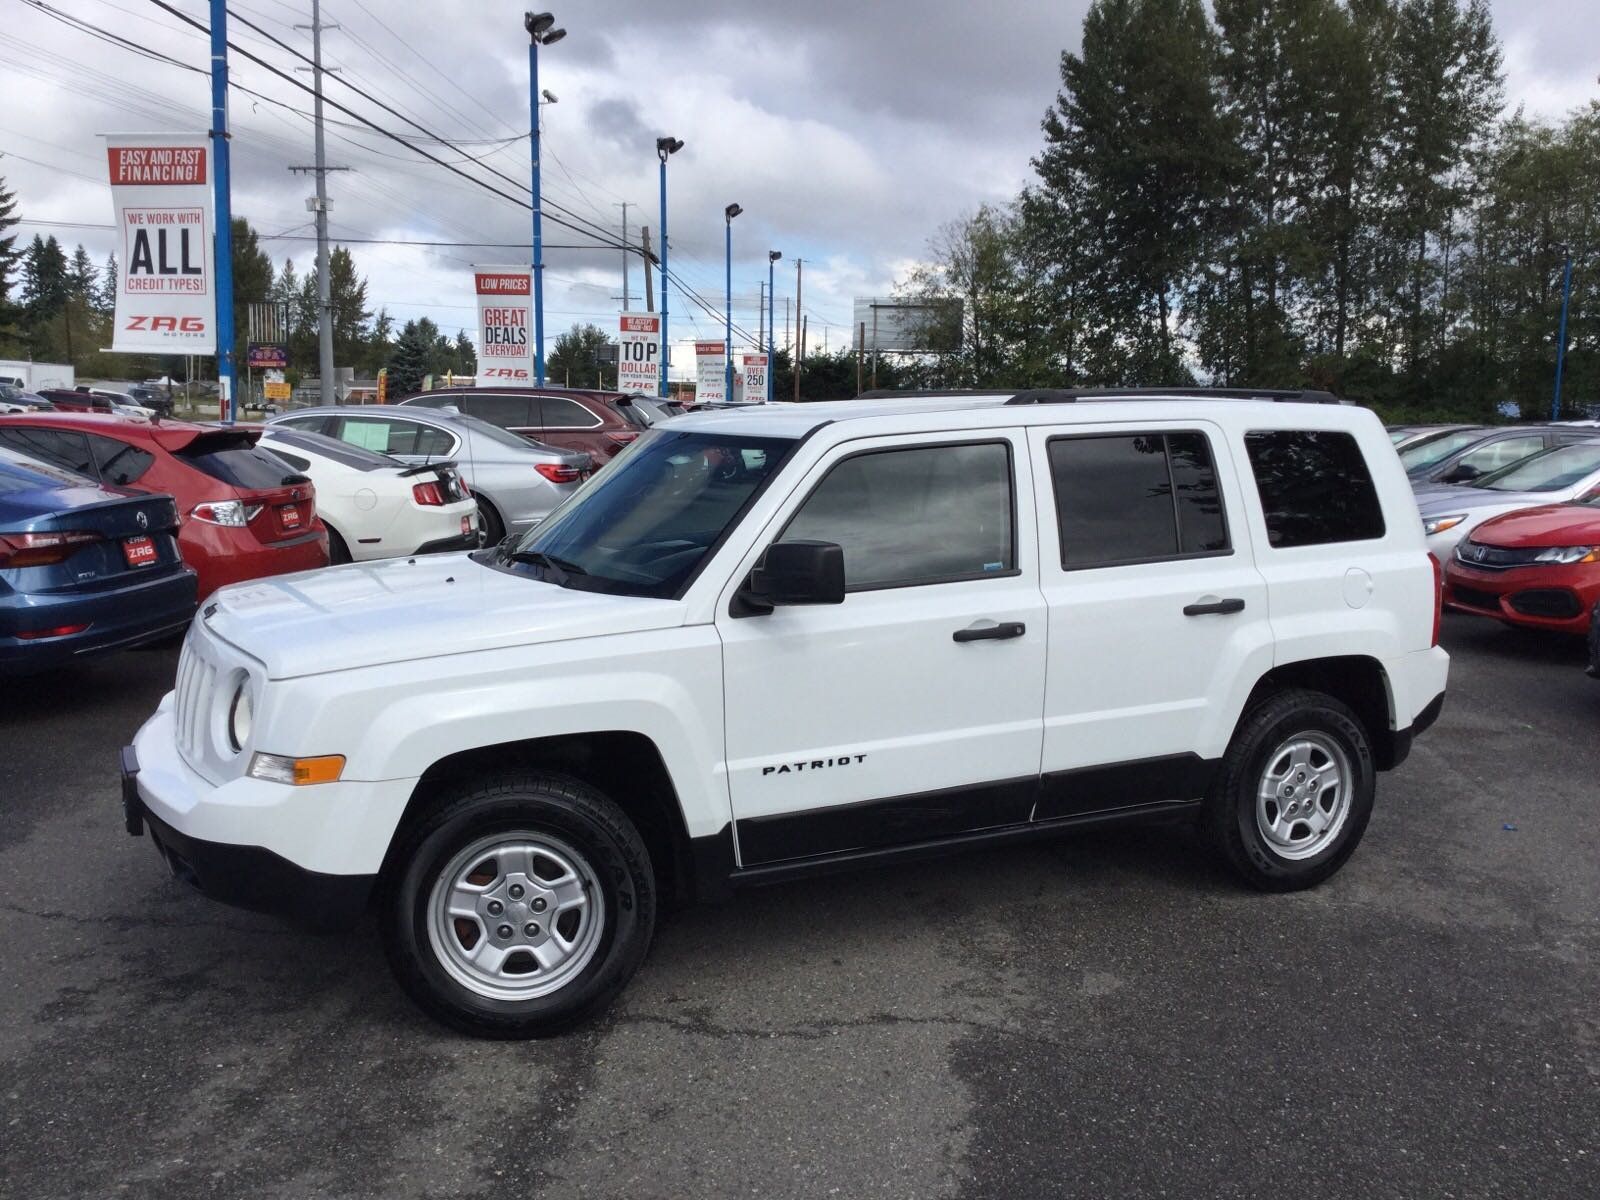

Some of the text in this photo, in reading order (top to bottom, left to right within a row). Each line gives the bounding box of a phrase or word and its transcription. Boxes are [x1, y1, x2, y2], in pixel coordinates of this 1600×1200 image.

[120, 150, 200, 165] EASY AND FAST
[120, 166, 199, 181] FINANCING!
[128, 213, 200, 225] WE WORK WITH
[129, 228, 202, 275] ALL
[128, 278, 204, 291] CREDIT TYPES!
[480, 278, 528, 290] LOW PRICES
[125, 316, 205, 331] ZAG
[484, 308, 526, 327] GREAT
[485, 327, 526, 345] DEALS
[485, 345, 526, 356] EVERYDAY
[622, 341, 658, 362] TOP
[484, 368, 529, 378] ZAG
[621, 362, 657, 374] DOLLAR
[747, 367, 765, 375] OVER
[623, 381, 654, 389] ZAG
[747, 374, 764, 386] 250
[128, 545, 153, 559] ZAG
[762, 754, 867, 776] PATRIOT
